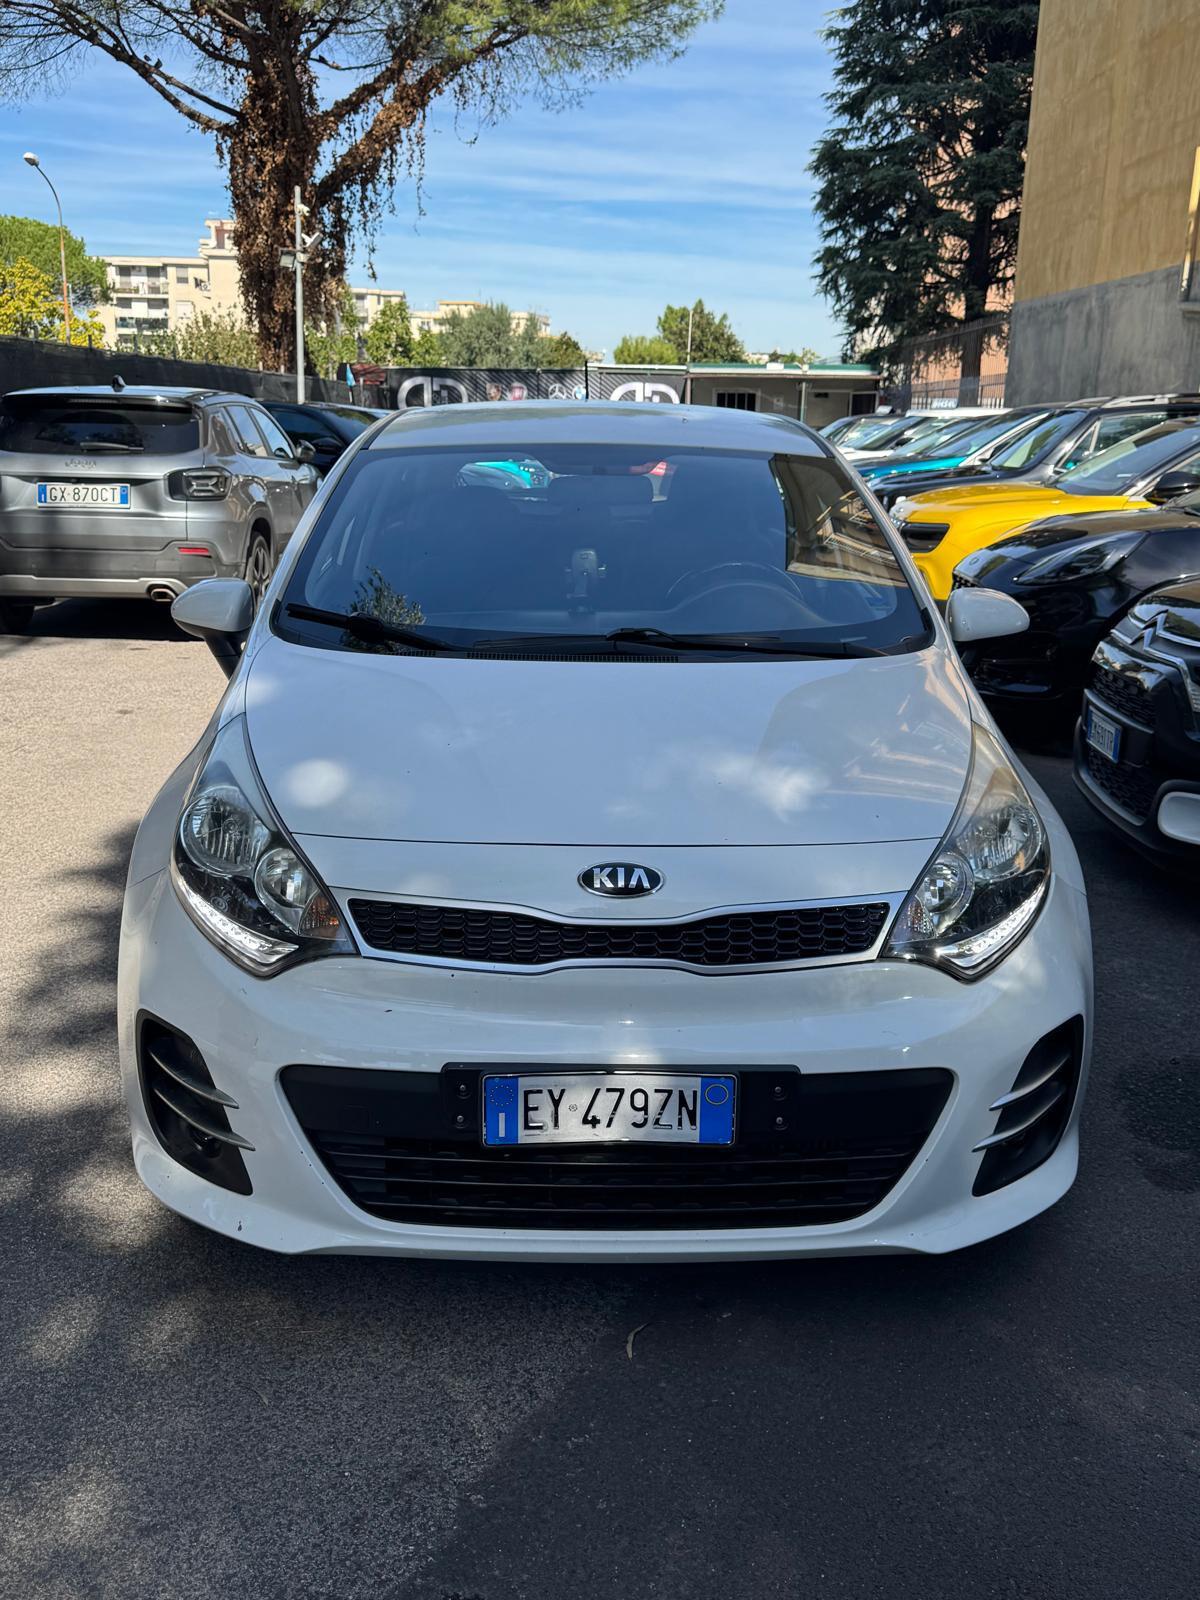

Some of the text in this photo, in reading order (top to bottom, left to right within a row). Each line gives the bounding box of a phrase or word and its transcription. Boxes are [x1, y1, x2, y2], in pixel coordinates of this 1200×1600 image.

[49, 487, 66, 502] GX
[73, 487, 117, 502] 870CT
[592, 867, 651, 889] KIA
[523, 1088, 566, 1131] EY
[581, 1087, 698, 1131] 479ZN
